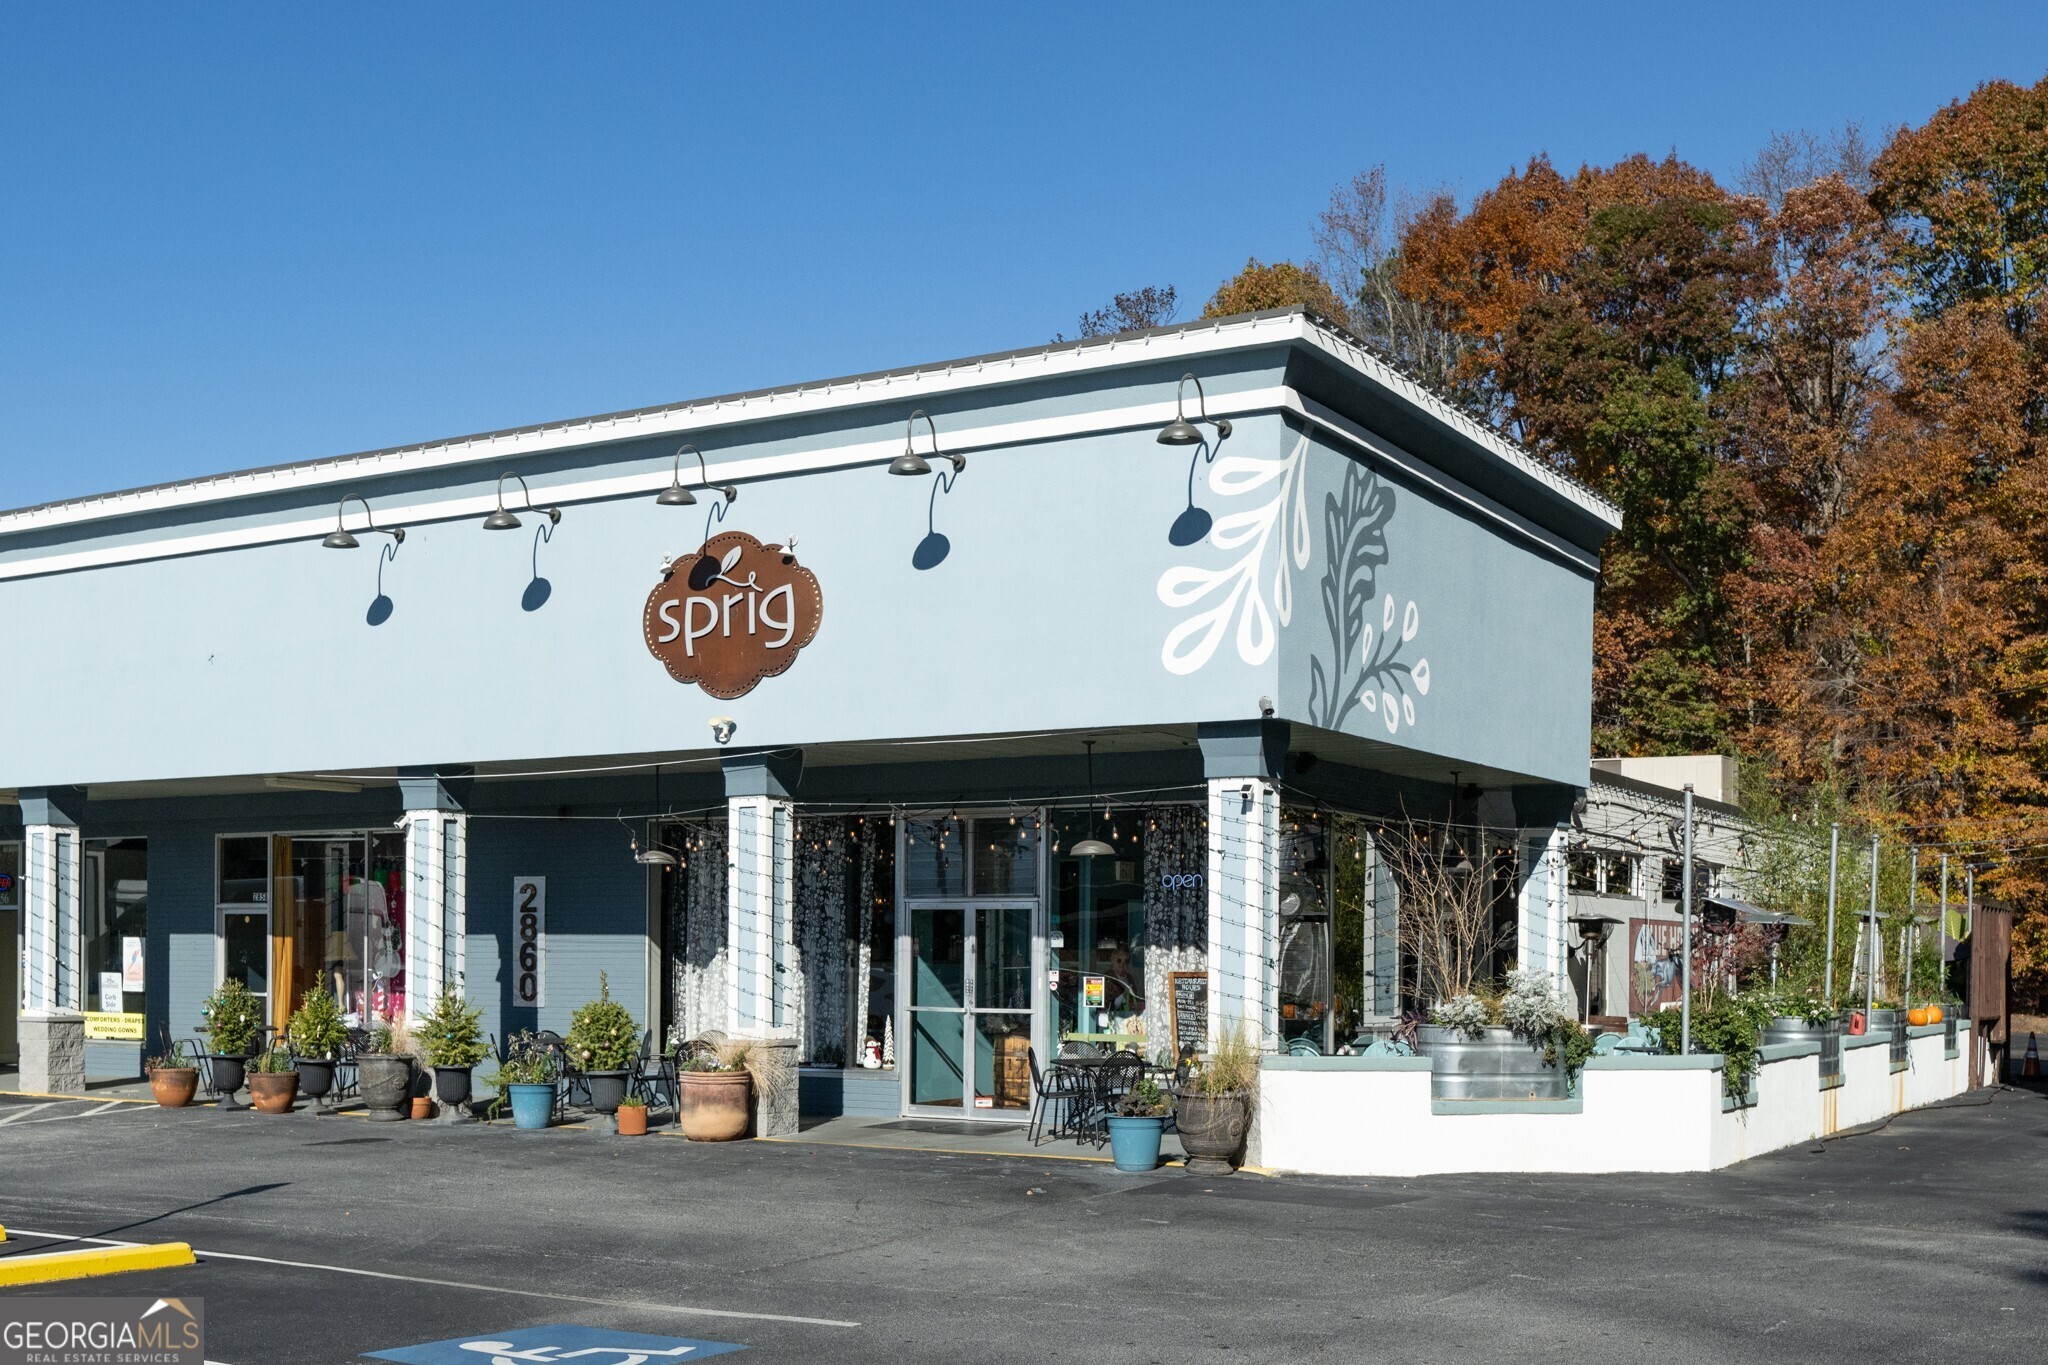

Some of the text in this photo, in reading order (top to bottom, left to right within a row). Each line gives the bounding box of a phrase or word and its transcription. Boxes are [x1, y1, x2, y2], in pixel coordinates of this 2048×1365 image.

[658, 583, 796, 657] sprig
[1162, 874, 1203, 891] open
[519, 883, 538, 1002] 2860
